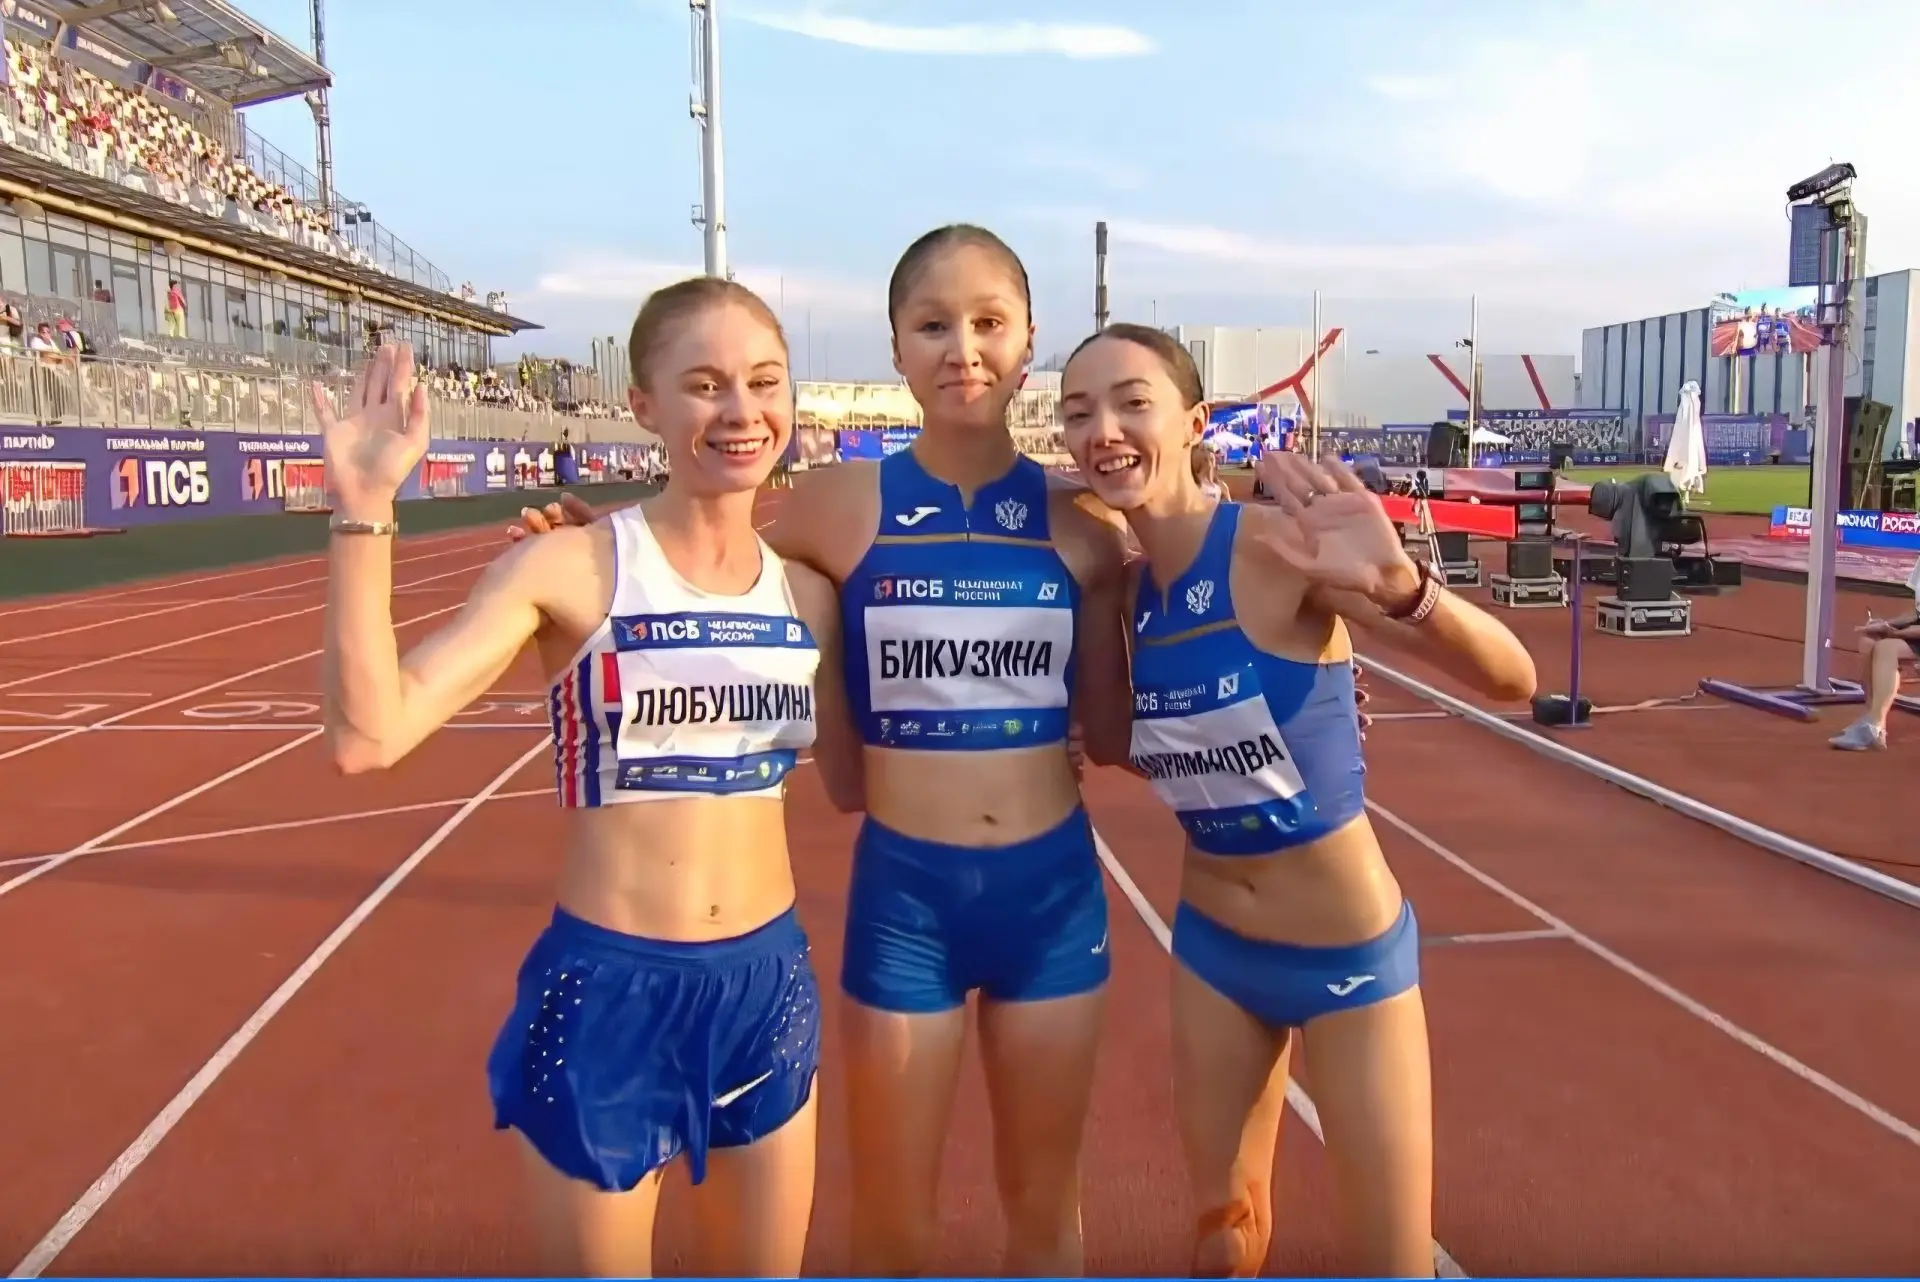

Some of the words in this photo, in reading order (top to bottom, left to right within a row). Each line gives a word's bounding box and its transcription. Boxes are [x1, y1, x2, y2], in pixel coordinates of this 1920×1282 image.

[145, 460, 209, 505] ПСБ
[896, 579, 944, 598] ПСБ
[651, 619, 700, 641] ПСБ
[880, 639, 1053, 680] БИКУЗИНА
[631, 683, 813, 726] ЛЮБУШКИНА
